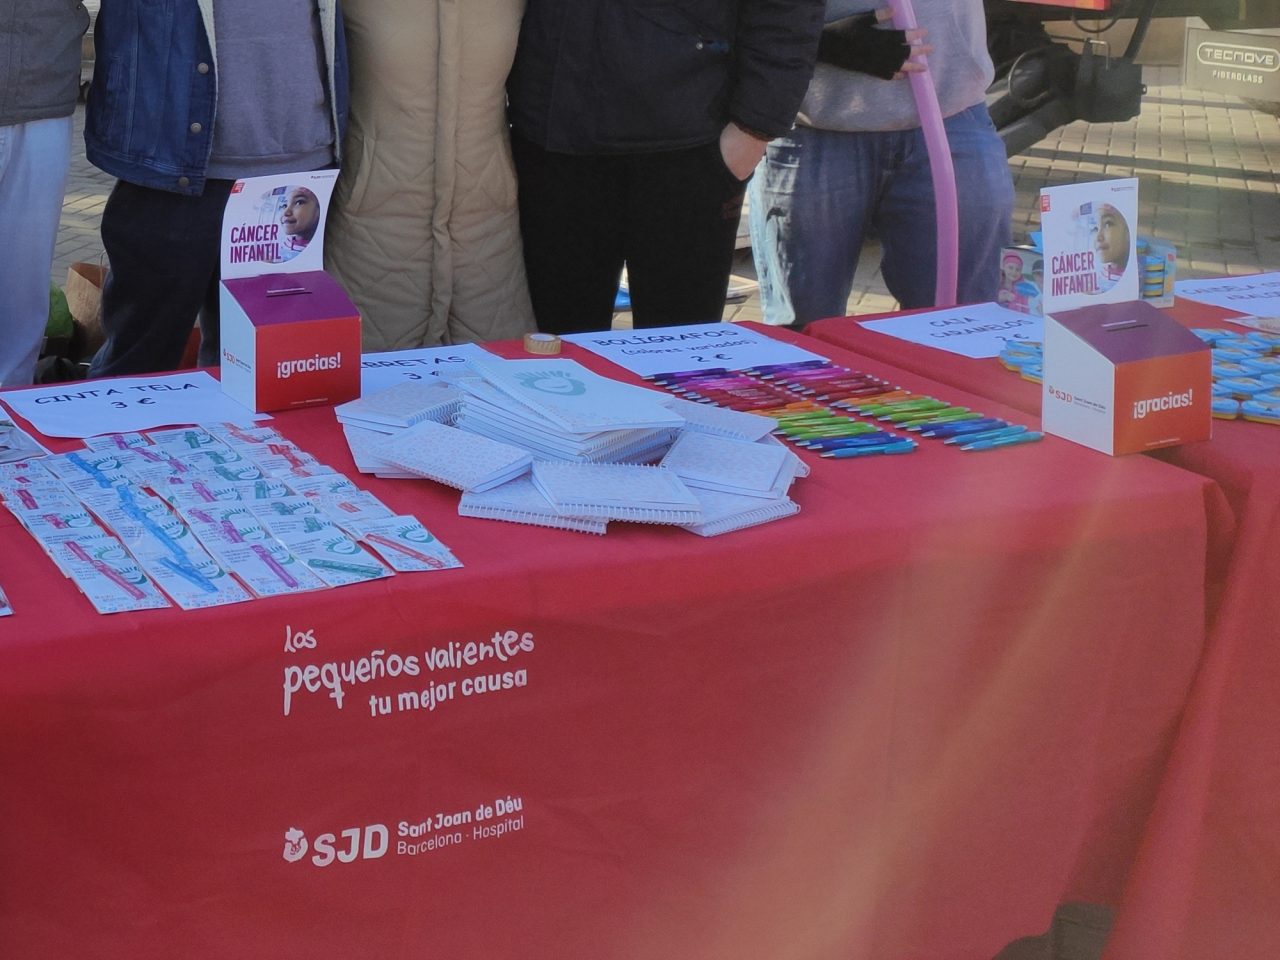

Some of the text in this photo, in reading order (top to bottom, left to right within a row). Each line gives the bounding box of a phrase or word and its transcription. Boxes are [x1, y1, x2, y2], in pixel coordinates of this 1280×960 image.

[1204, 47, 1274, 65] TECNOVE
[230, 223, 278, 244] CÁNCER
[230, 243, 281, 263] INFANTIL
[1051, 251, 1095, 275] CÁNCER
[1051, 272, 1100, 297] INFANTIL
[592, 329, 739, 346] BOLÍGRAFOS
[929, 319, 1034, 339] CARAMELOS
[277, 352, 341, 378] ¡gracias!
[402, 372, 422, 380] 3
[34, 383, 200, 404] CINTA TELA
[111, 397, 156, 409] 3 €
[1133, 389, 1193, 419] ¡gracias!
[283, 625, 317, 653] los
[283, 630, 535, 716] pequeños valientes
[369, 669, 527, 717] tu mejor causa
[397, 795, 523, 838] Sant Joan de Déu
[311, 823, 389, 867] SJD
[397, 815, 524, 856] Barcelona Hospital
